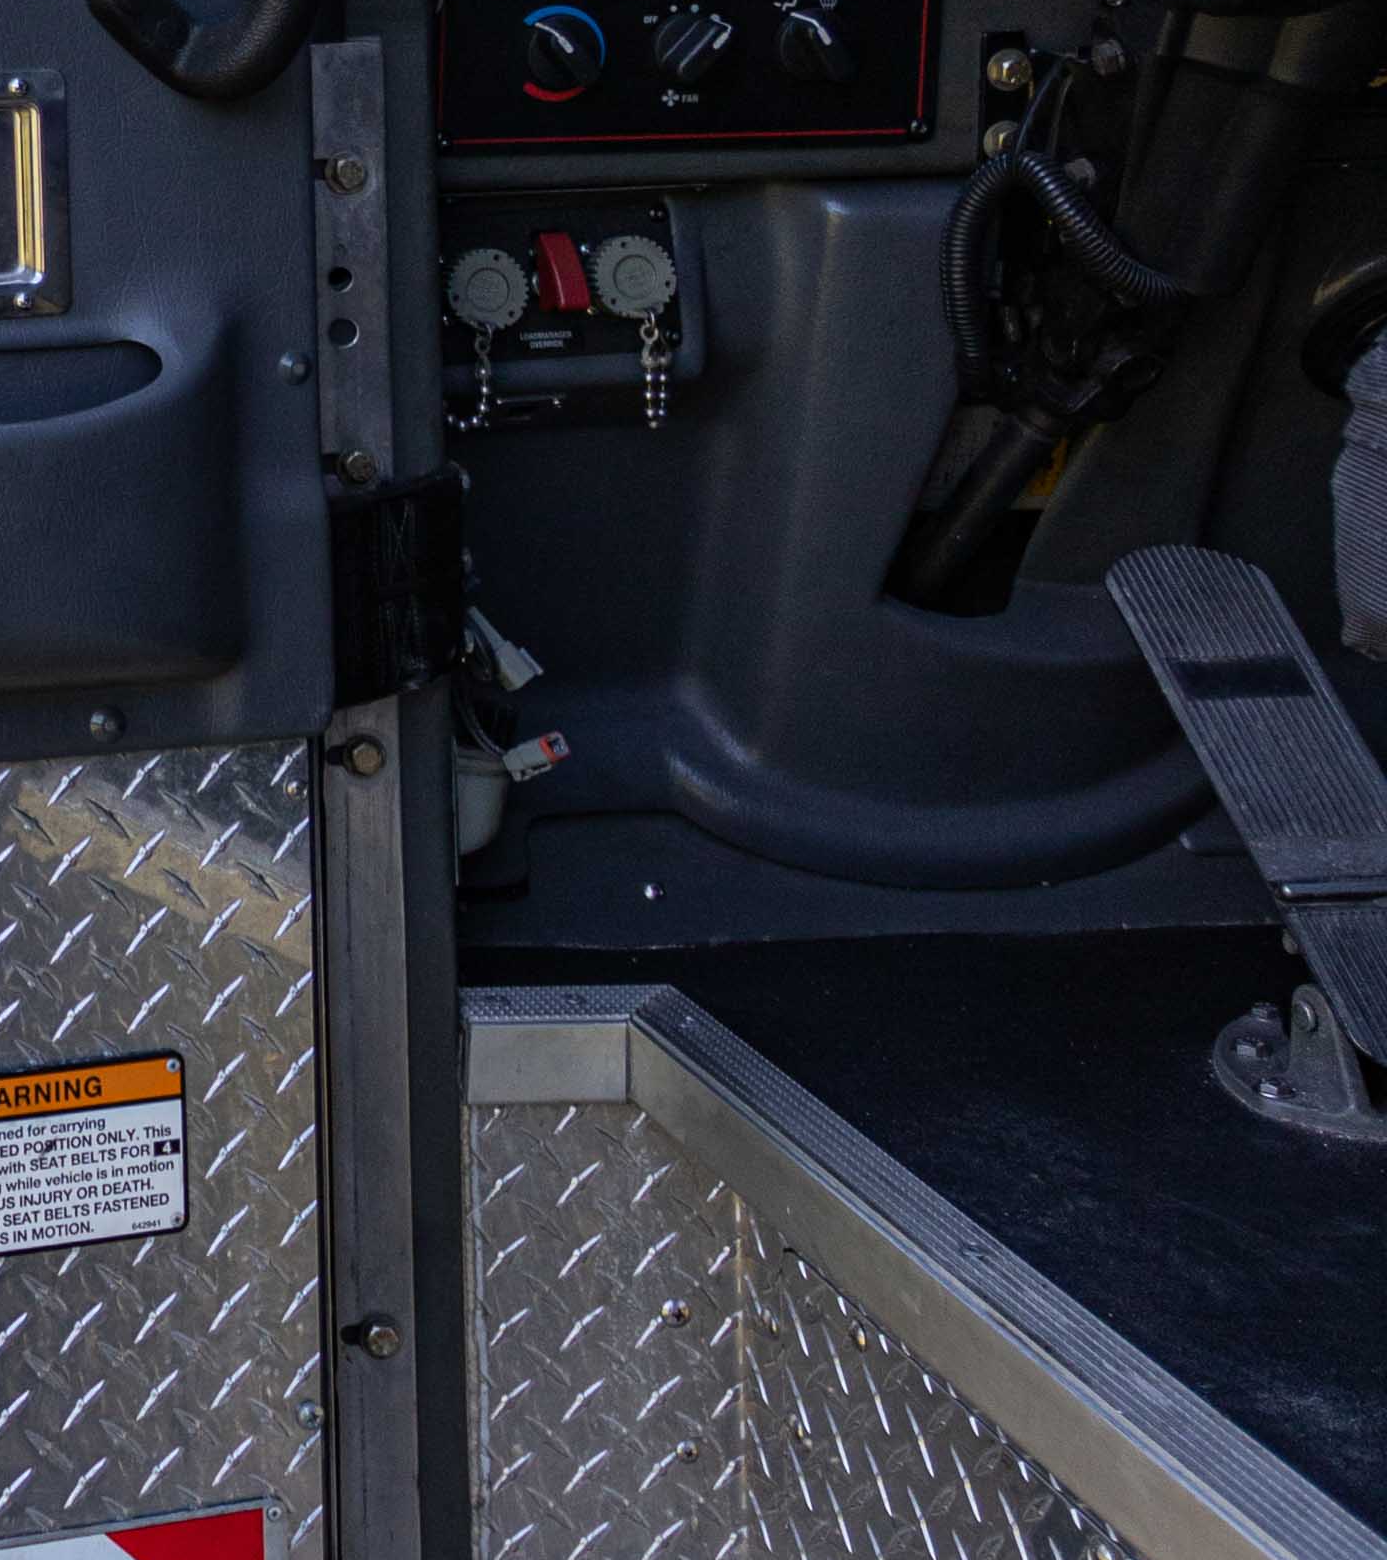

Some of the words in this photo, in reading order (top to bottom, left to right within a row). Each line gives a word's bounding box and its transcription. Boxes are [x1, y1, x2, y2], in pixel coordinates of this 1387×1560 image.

[23, 1133, 93, 1156] POSITION
[95, 1128, 140, 1146] ONLY.
[142, 1124, 172, 1139] This
[27, 1124, 47, 1138] for
[50, 1117, 106, 1135] carrying
[29, 1154, 68, 1172] SEAT
[70, 1148, 118, 1167] BELTS
[120, 1143, 151, 1160] FOR
[162, 1139, 173, 1156] 4
[5, 1176, 42, 1193] while
[44, 1169, 93, 1187] vehicle
[96, 1167, 108, 1180] is
[111, 1165, 124, 1178] in
[127, 1159, 175, 1176] motion
[19, 1188, 73, 1208] INJURY
[76, 1185, 99, 1200] OR
[102, 1177, 155, 1197] DEATH.
[2, 1209, 41, 1228] SEAT
[44, 1203, 91, 1222] BELTS
[93, 1192, 170, 1215] FASTENED
[12, 1229, 28, 1244] IN
[31, 1220, 95, 1241] MOTION.
